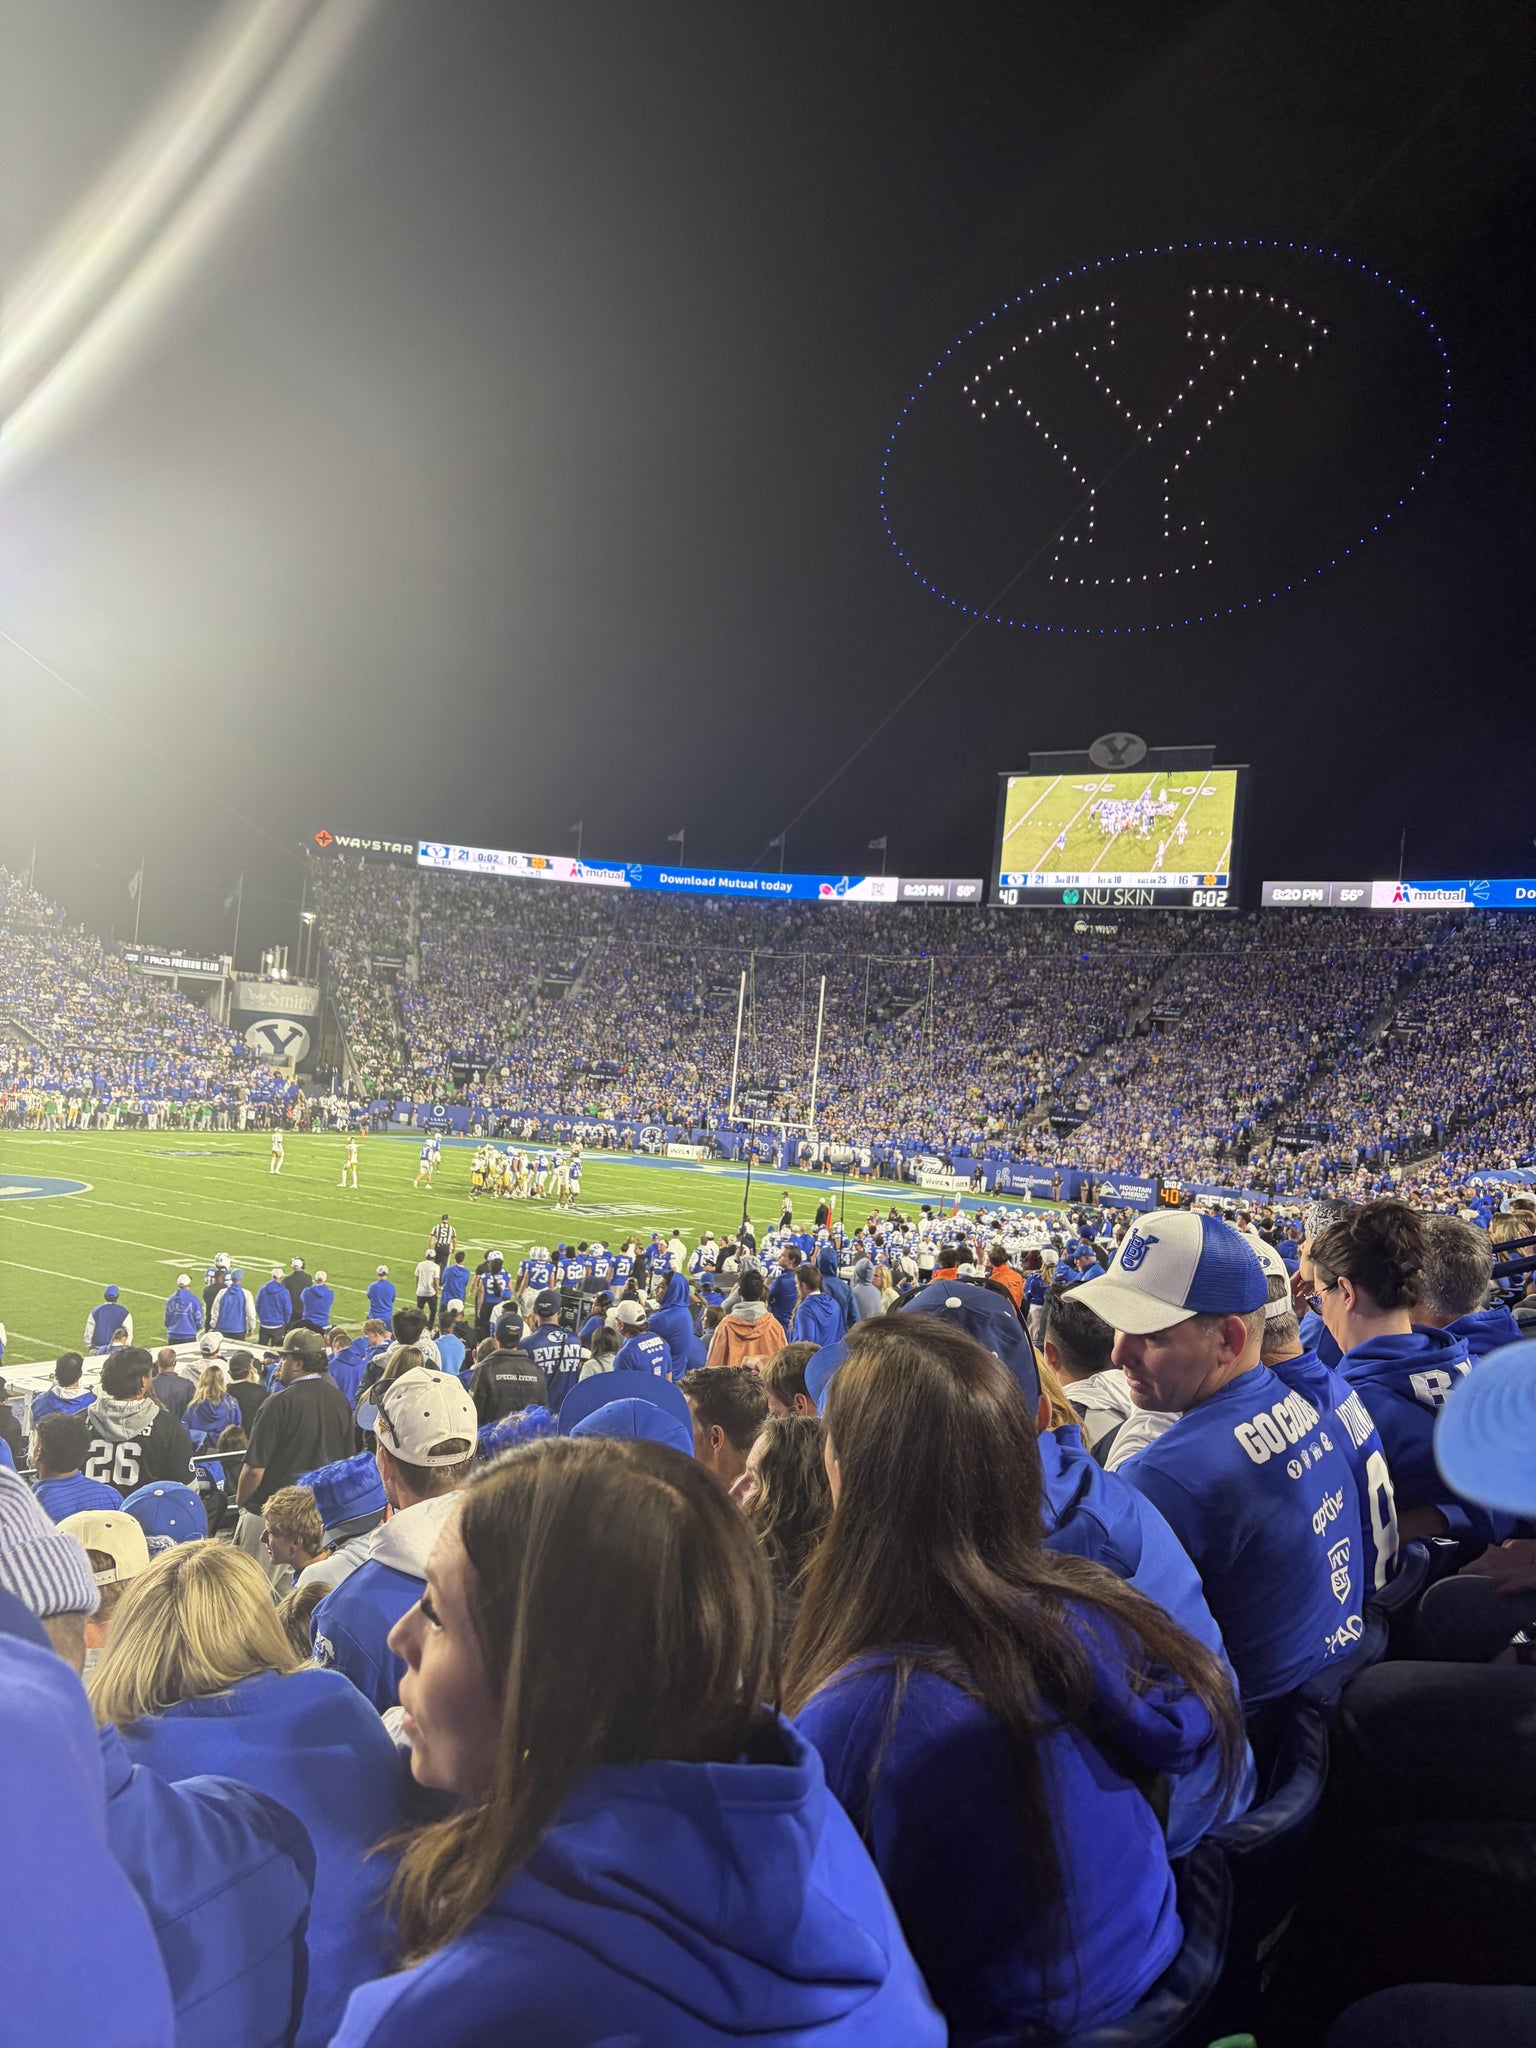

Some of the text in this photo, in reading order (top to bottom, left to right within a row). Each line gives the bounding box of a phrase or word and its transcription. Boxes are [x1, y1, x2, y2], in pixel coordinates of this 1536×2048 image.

[335, 835, 413, 855] WAYSTAR
[458, 849, 518, 866] 21 0:02 16
[586, 868, 625, 881] mutual
[1034, 875, 1044, 884] 21
[1157, 876, 1167, 884] 25
[659, 873, 793, 893] Download Mutual today
[926, 884, 945, 897] PM
[998, 889, 1018, 905] 40
[1083, 888, 1154, 906] NU SKIN
[1192, 890, 1228, 907] 0:02
[1272, 888, 1323, 901] 8:20 PM
[1414, 887, 1465, 901] mutual
[149, 955, 171, 966] PACS
[171, 958, 201, 969] PREMIUM
[202, 961, 219, 972] CLUB
[1119, 1184, 1152, 1194] MOUNTAIN
[1164, 1180, 1182, 1190] 0:02
[1120, 1191, 1149, 1199] AMERICA
[1160, 1188, 1179, 1205] 40
[440, 1227, 448, 1238] S
[530, 1267, 549, 1284] 73
[567, 1265, 584, 1280] 62
[595, 1262, 610, 1277] 57
[617, 1262, 631, 1276] 21
[532, 1343, 581, 1361] EVENT
[1234, 1412, 1287, 1465] GO
[85, 1439, 142, 1487] 26
[1312, 1487, 1344, 1537] aptive
